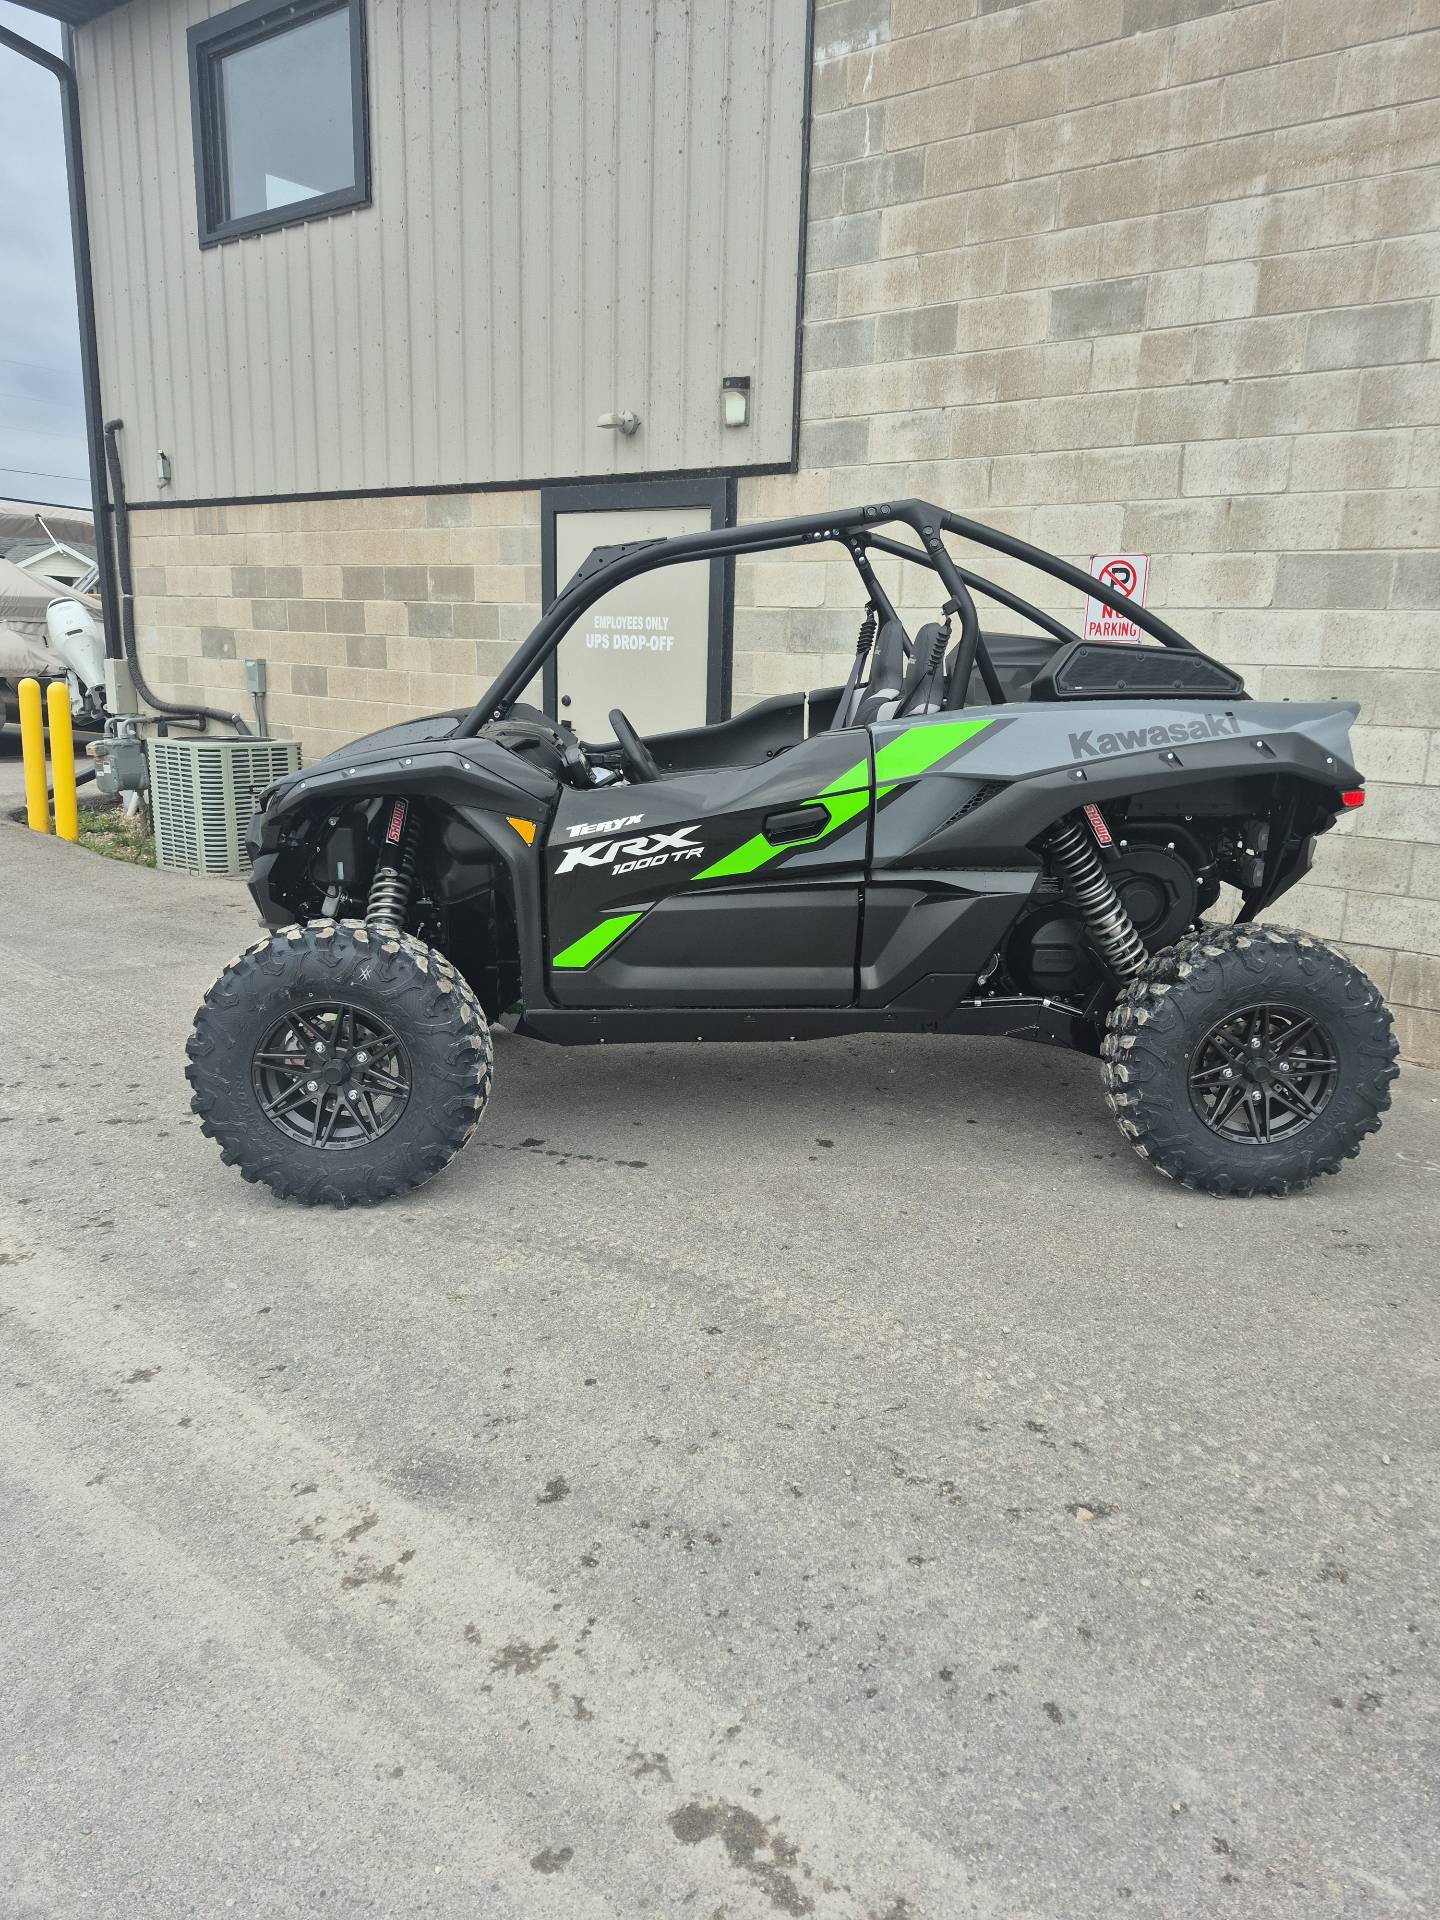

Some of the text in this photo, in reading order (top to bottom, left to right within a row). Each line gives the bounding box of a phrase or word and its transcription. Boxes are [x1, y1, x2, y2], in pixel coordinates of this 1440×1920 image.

[594, 615, 669, 631] EMPLOYEES ONLY
[1089, 621, 1137, 637] PARKING
[586, 633, 674, 651] UPS DROP-OFF
[1067, 711, 1241, 760] Kawasaki
[389, 800, 406, 842] SHOWA
[554, 824, 703, 875] KRX
